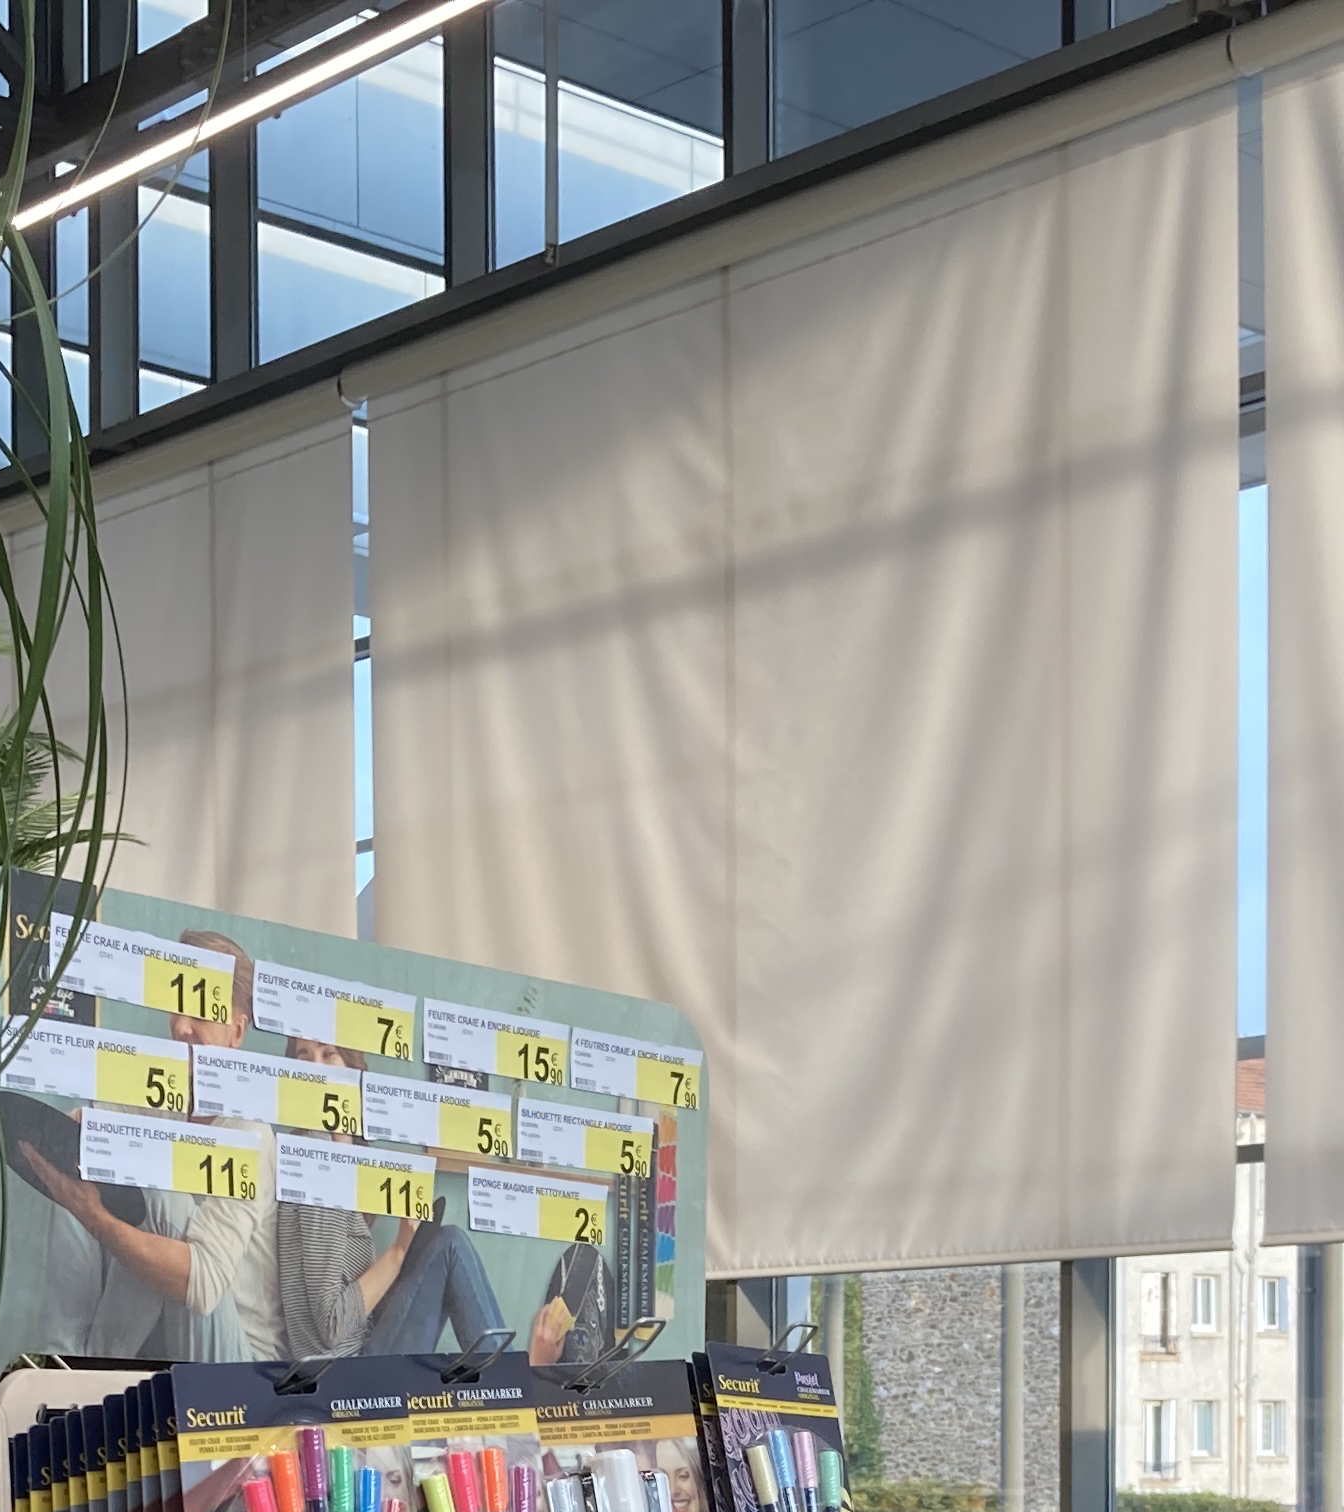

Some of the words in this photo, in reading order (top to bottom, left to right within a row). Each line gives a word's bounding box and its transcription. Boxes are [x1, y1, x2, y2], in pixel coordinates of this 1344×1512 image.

[93, 935, 121, 951] CRAIE
[122, 942, 130, 953] A
[131, 944, 161, 960] ENCRE
[163, 950, 198, 969] LIQUIDE
[257, 972, 290, 988] FEUTRE
[291, 980, 316, 995] CRAIE
[316, 986, 323, 997] A
[325, 987, 352, 1003] ENCRE
[353, 994, 383, 1010] LIQUIDE
[427, 1009, 456, 1024] FEUTRE
[457, 1015, 479, 1028] CRAIE
[480, 1019, 486, 1029] A
[487, 1020, 511, 1034] ENCRE
[512, 1025, 540, 1039] LIQUIDE
[65, 1034, 95, 1050] FLEUR
[97, 1041, 137, 1057] ARDOISE
[580, 1039, 610, 1053] FEUTRES
[611, 1044, 630, 1056] CRAIE
[638, 1050, 658, 1062] ENCRE
[659, 1053, 684, 1066] LIQUIDE
[197, 1055, 248, 1073] SILHOUETTE
[250, 1063, 291, 1079] PAPILLON
[292, 1071, 327, 1085] ARDOISE
[365, 1082, 412, 1099] SILHOUETTE
[414, 1091, 438, 1104] BULLE
[439, 1095, 471, 1108] ARDOISE
[520, 1107, 562, 1123] SILHOUETTE
[563, 1114, 603, 1130] RECTANGLE
[603, 1121, 633, 1133] ARDOISE
[86, 1119, 142, 1138] SILHOUETTE
[143, 1128, 178, 1143] FLECHE
[179, 1133, 217, 1148] ARDOISE
[280, 1144, 330, 1162] SILHOUETTE
[331, 1152, 377, 1169] RECTANGLE
[378, 1161, 413, 1174] ARDOISE
[472, 1177, 502, 1192] EPONGE
[503, 1181, 535, 1196] MAGIQUE
[536, 1187, 580, 1201] NETTOYANTE
[641, 1228, 650, 1318] CHALKMARKE
[456, 1387, 524, 1401] CHALKMARKER
[717, 1374, 761, 1394] Securit
[186, 1405, 246, 1428] Securit
[330, 1396, 402, 1411] CHALKMARKER
[535, 1401, 580, 1419] ecurit
[582, 1397, 654, 1411] CHALKMARKER
